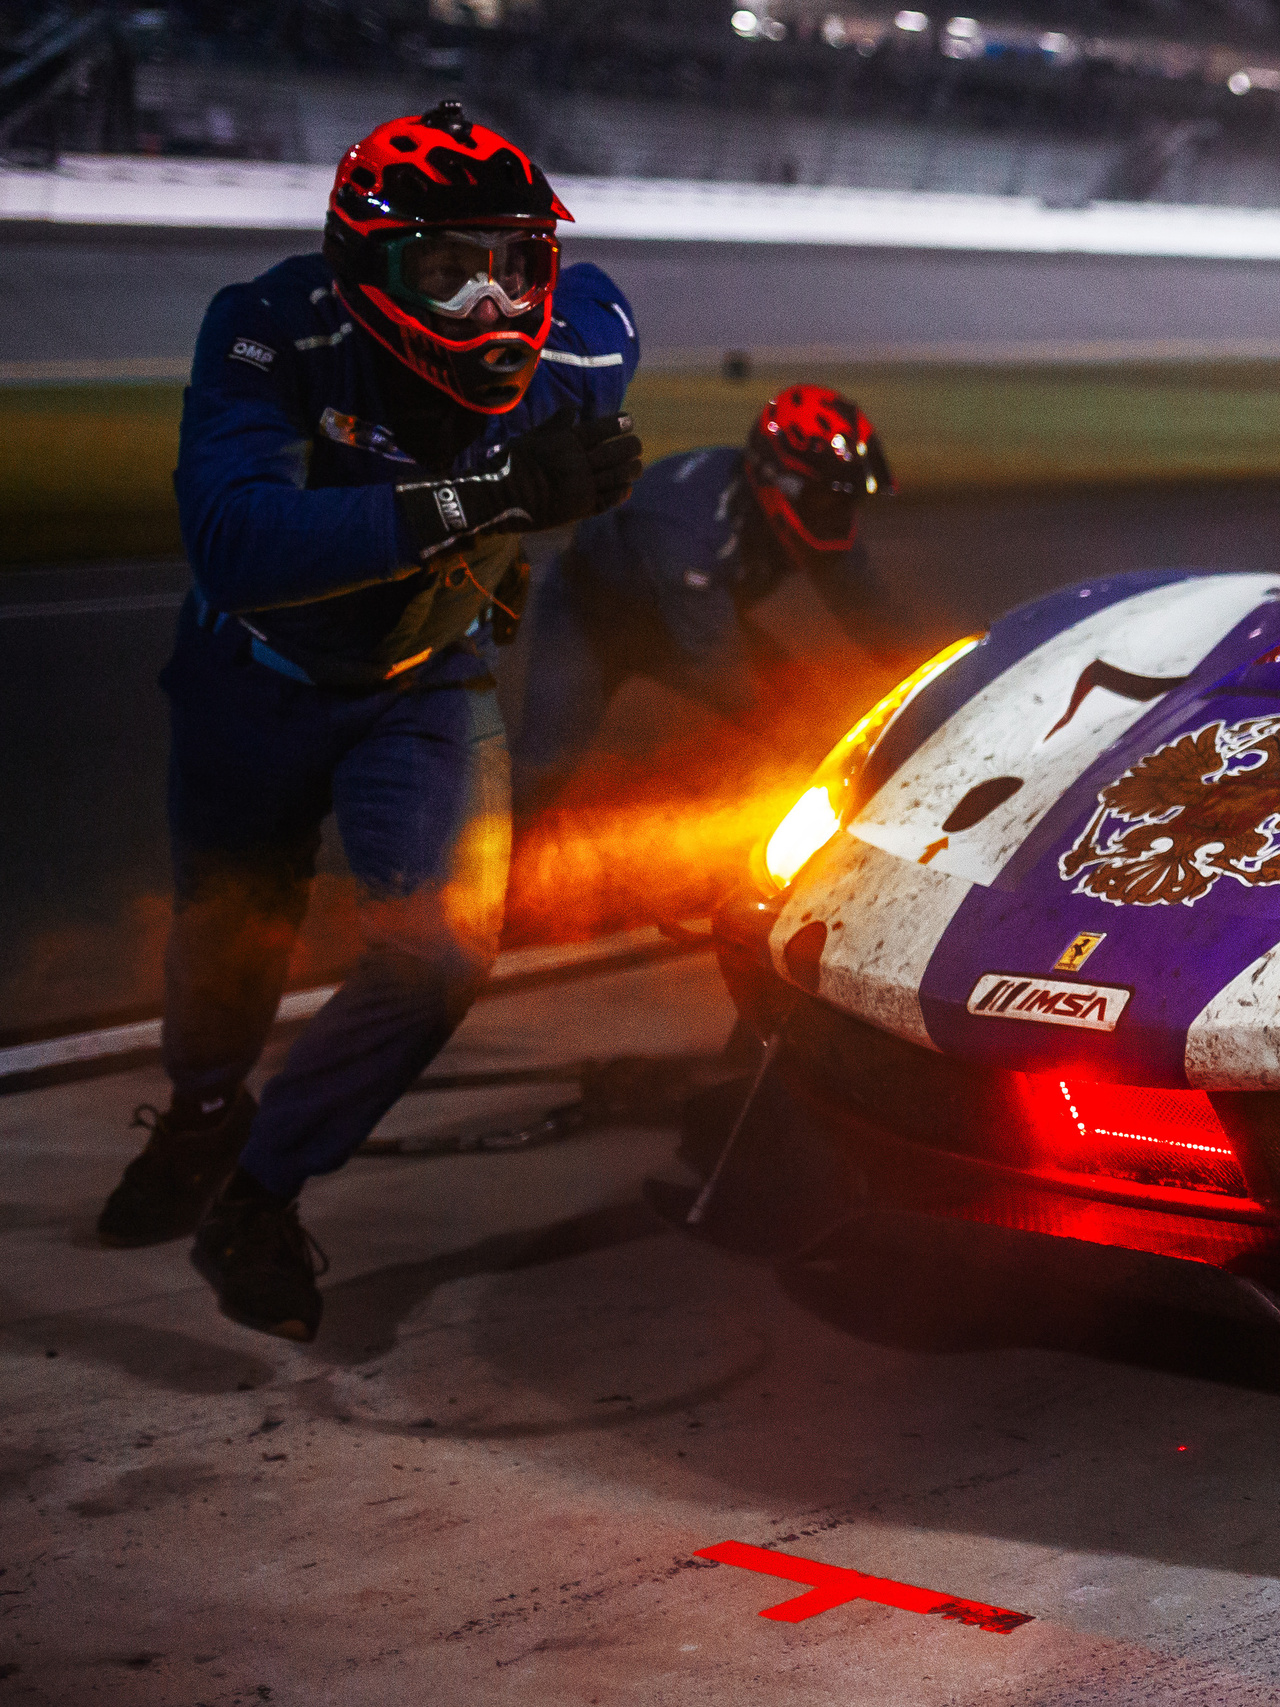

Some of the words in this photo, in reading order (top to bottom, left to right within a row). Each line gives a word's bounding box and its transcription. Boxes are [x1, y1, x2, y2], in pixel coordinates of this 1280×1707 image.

[233, 342, 274, 362] OMP
[438, 488, 463, 529] OMP
[1016, 989, 1108, 1021] IMSA
